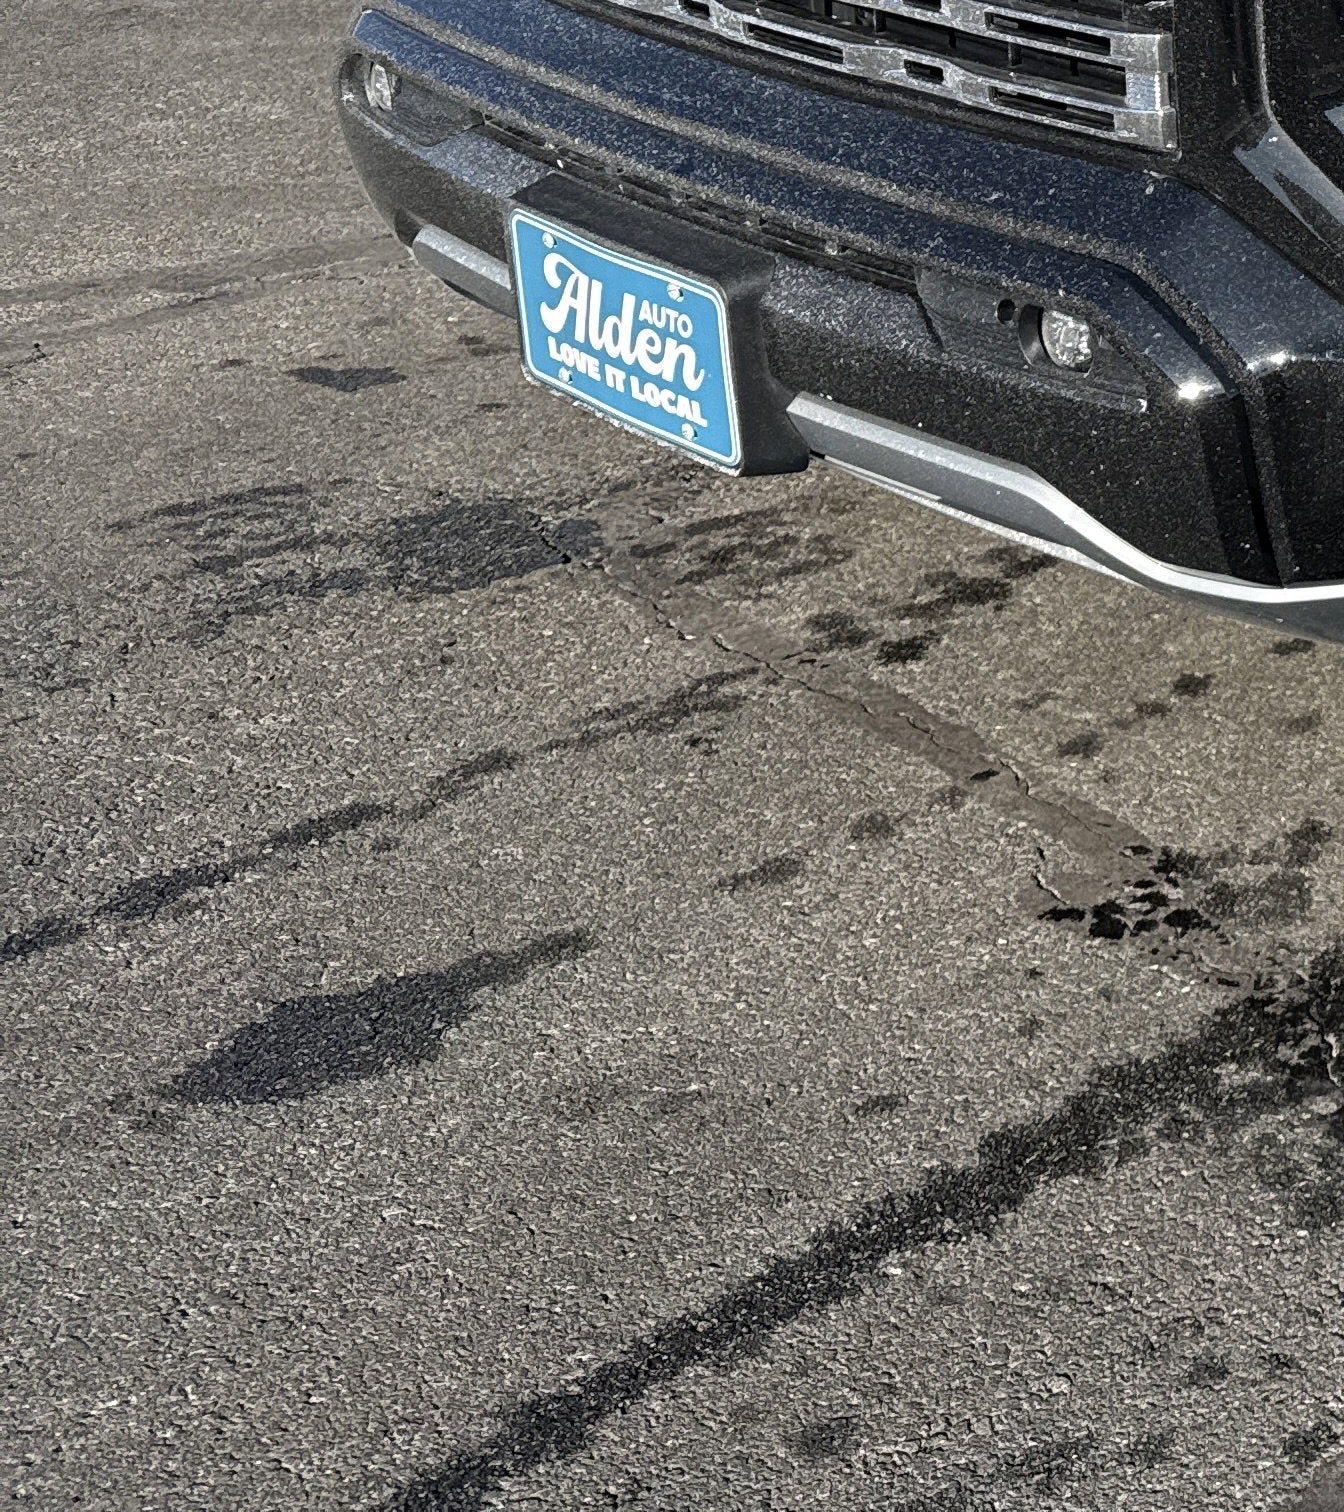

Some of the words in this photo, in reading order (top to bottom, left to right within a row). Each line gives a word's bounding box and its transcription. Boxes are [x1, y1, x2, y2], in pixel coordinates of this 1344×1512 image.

[540, 252, 705, 391] Alden
[638, 299, 693, 339] AUTO
[547, 335, 601, 382] LOVE
[604, 363, 627, 393] IT
[630, 375, 709, 428] LOCAL
